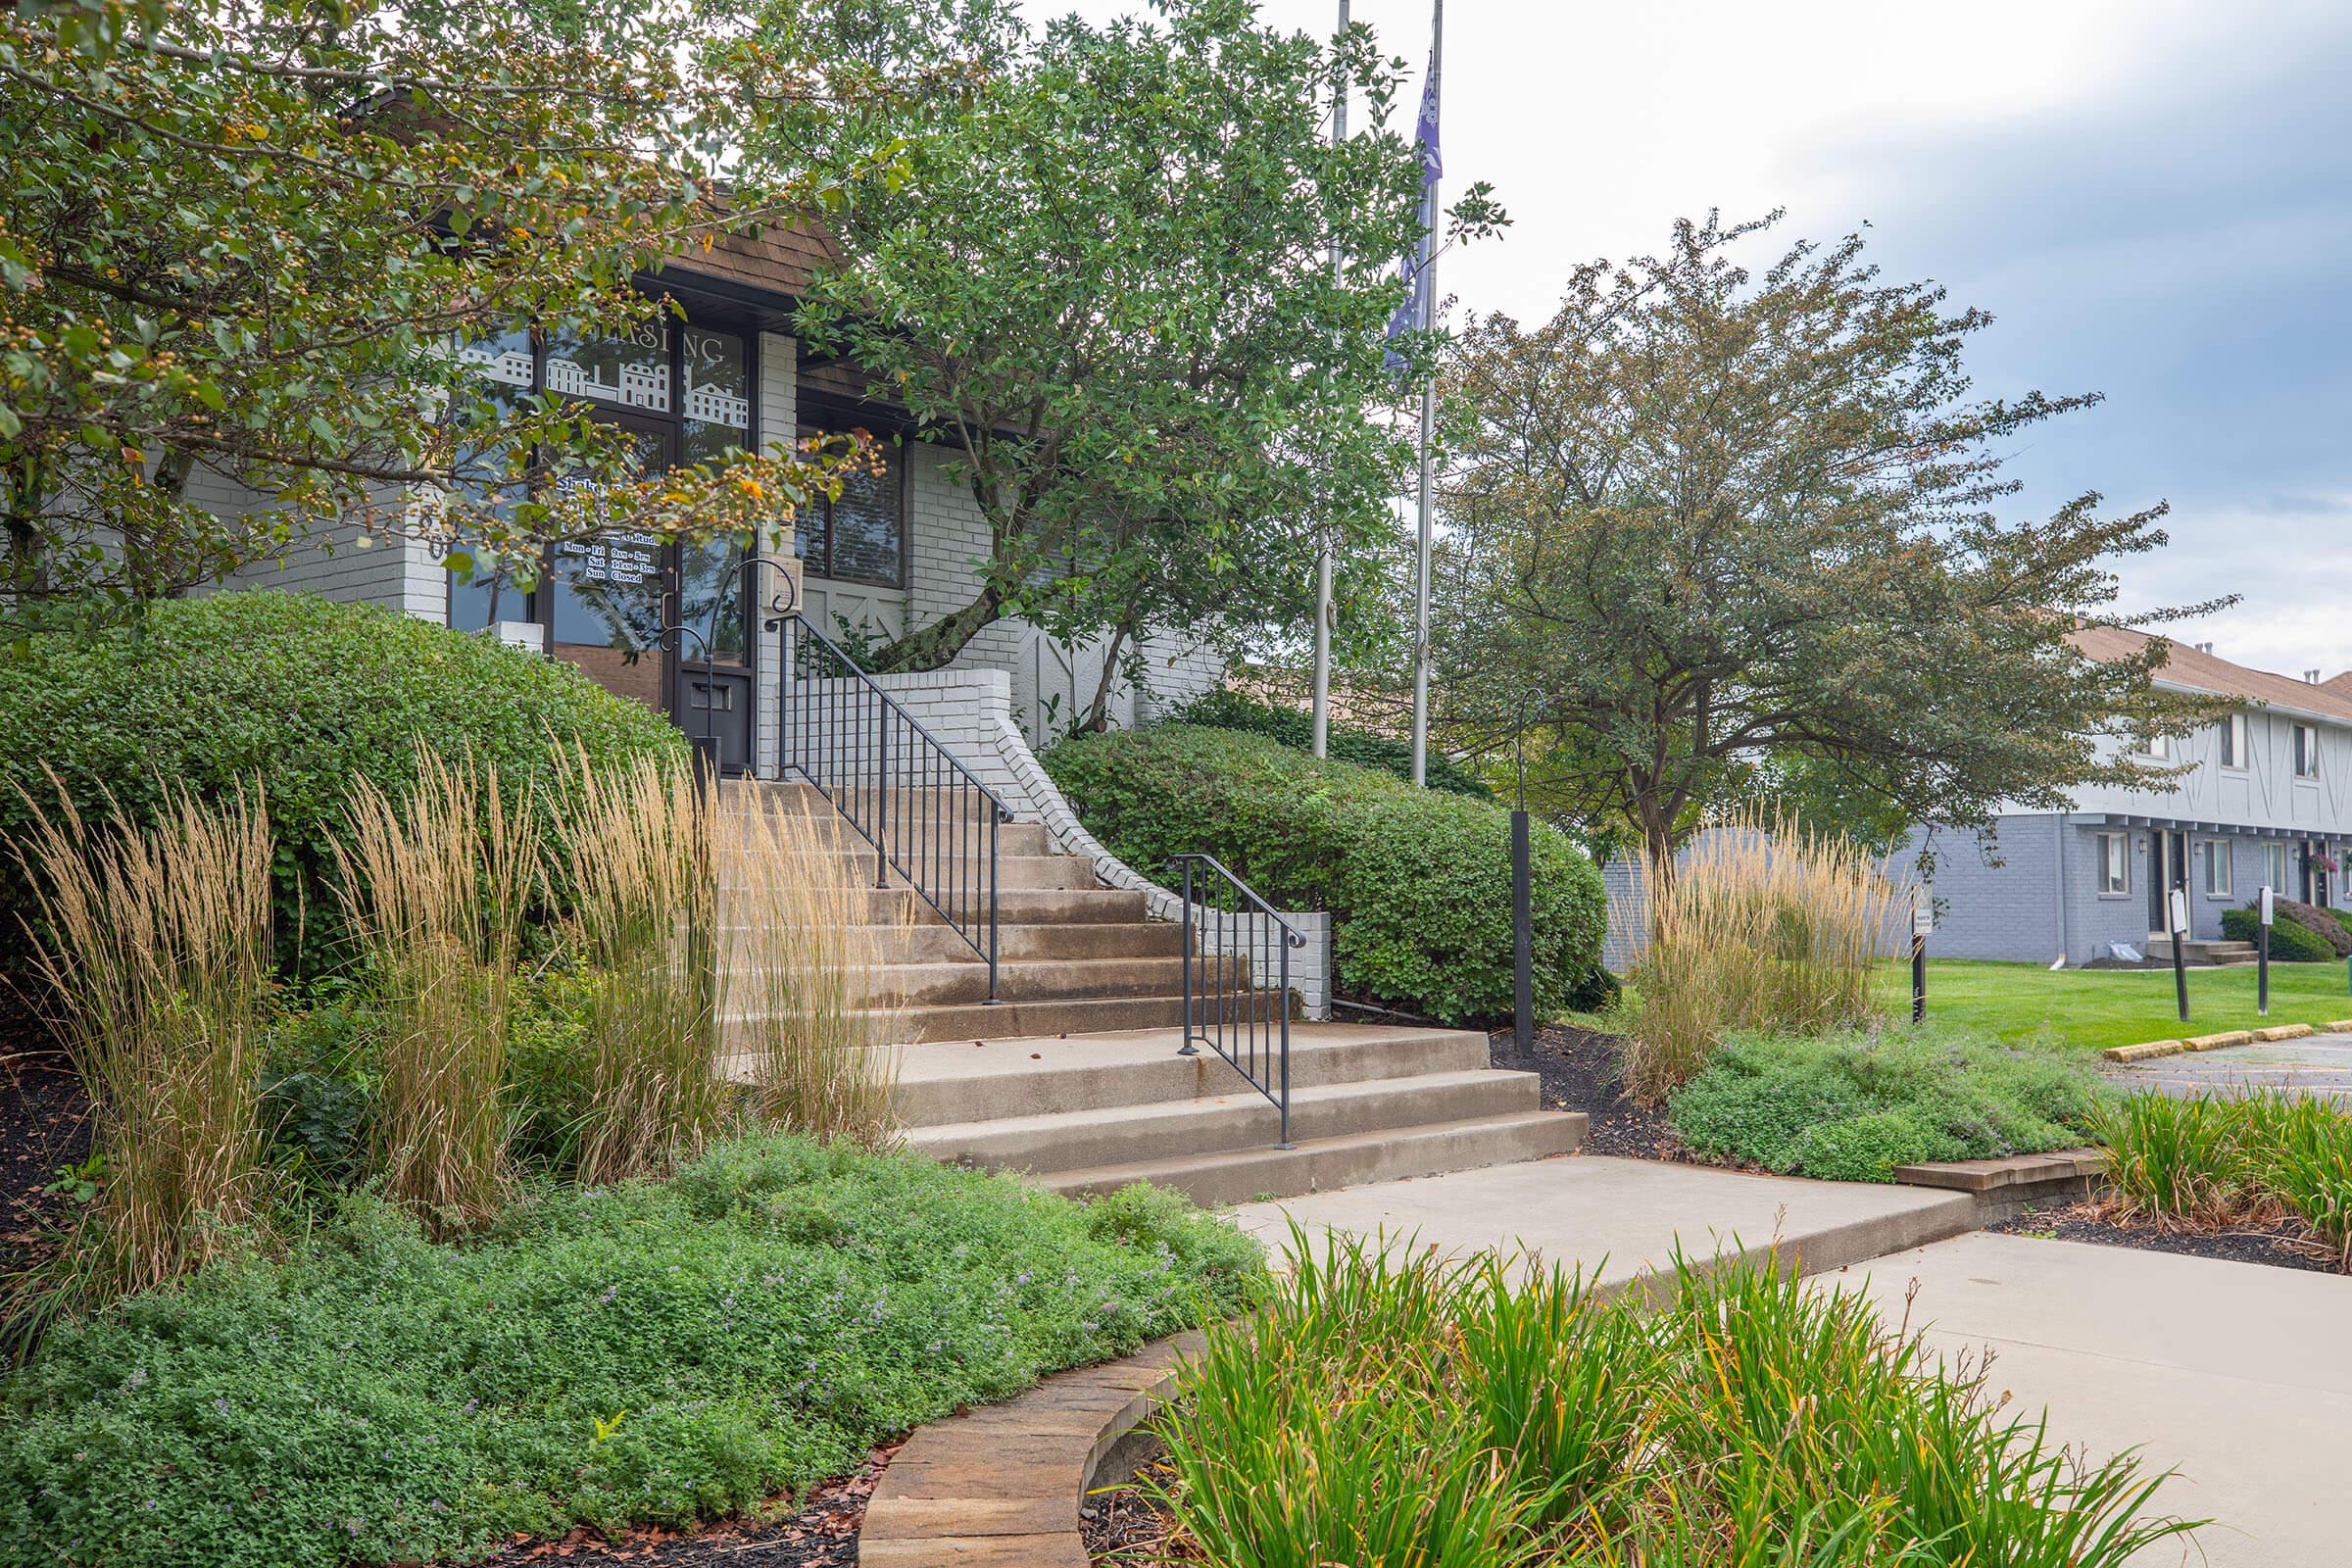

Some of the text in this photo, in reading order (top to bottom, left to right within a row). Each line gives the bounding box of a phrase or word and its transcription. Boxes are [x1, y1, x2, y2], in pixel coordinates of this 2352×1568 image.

[612, 316, 725, 363] ASING
[564, 541, 584, 554] Mon
[592, 546, 606, 556] Fri
[588, 557, 606, 567] Sat
[587, 567, 642, 583] Sun Closed
